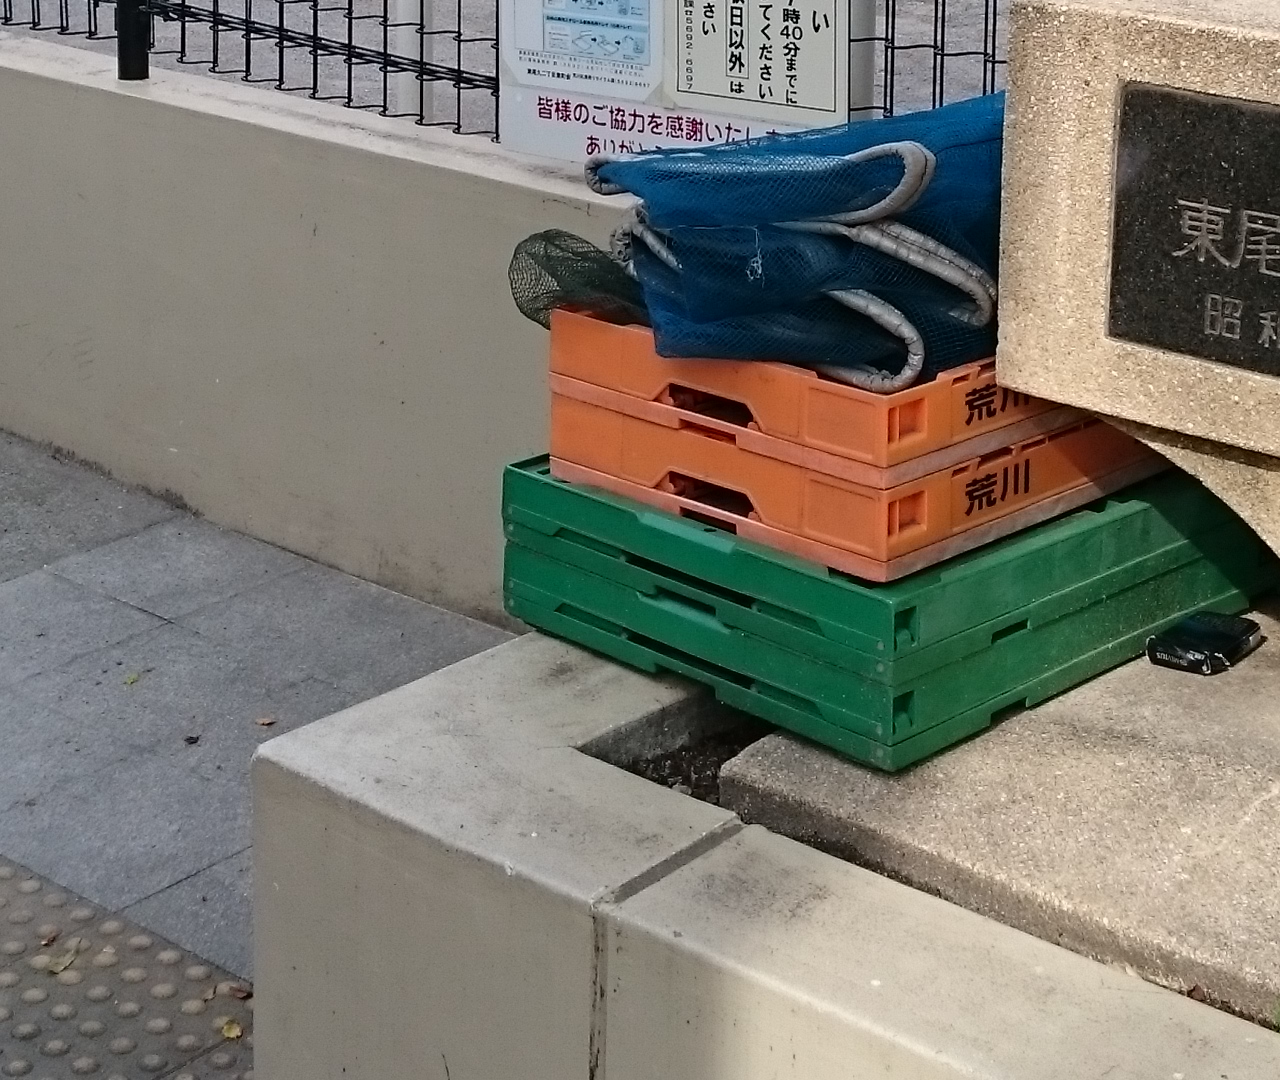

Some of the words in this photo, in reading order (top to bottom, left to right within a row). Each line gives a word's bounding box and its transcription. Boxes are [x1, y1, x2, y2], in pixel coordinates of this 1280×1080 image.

[537, 95, 778, 143] 皆様のご協力を感謝いたし
[965, 458, 1030, 517] 荒川
